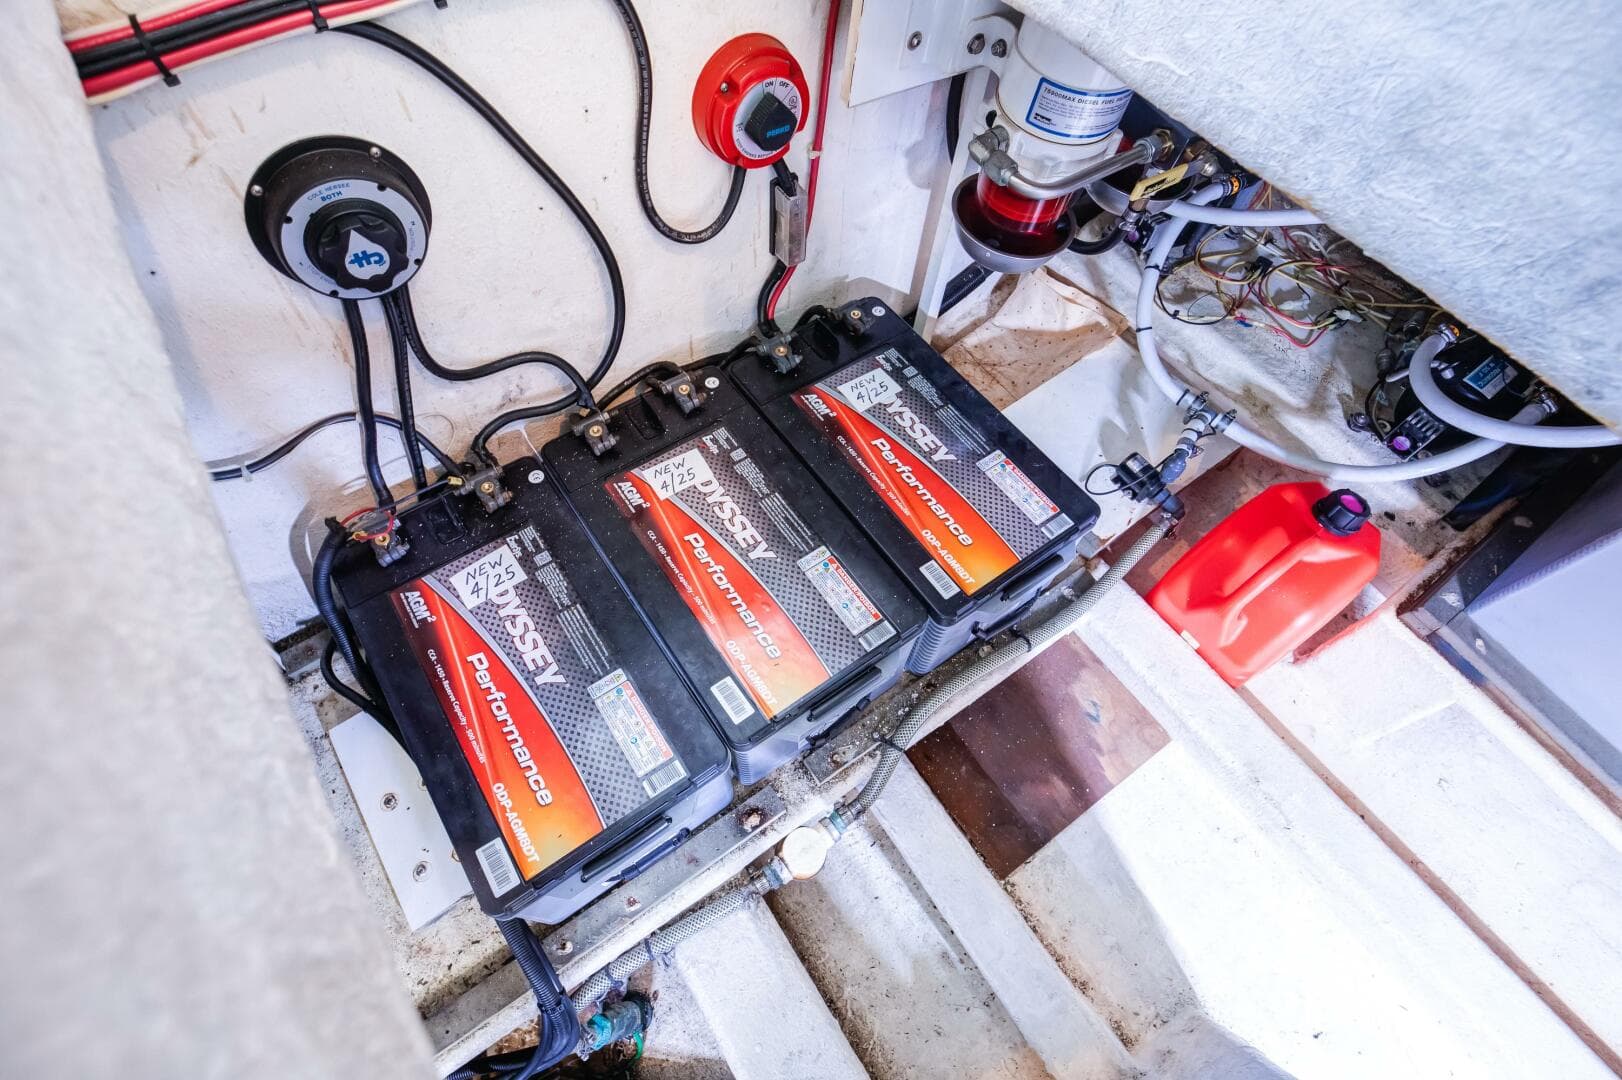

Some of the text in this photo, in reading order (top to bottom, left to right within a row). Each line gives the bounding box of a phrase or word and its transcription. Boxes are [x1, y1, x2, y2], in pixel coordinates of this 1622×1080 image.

[307, 182, 351, 201] COLE HERSEE
[320, 191, 343, 202] BOTH
[851, 374, 876, 392] NEW
[856, 382, 889, 404] 4/25
[654, 457, 685, 478] NEW
[660, 467, 696, 493] 4/25
[836, 434, 846, 445] CCA
[868, 471, 886, 490] Capacity
[694, 478, 777, 560] DYSSEY
[871, 437, 973, 546] Performance
[465, 553, 503, 585] NEW
[470, 564, 516, 600] 4/25
[646, 529, 656, 540] CCA
[664, 555, 679, 574] Reserve
[676, 572, 693, 594] Capacity
[684, 532, 782, 659] Performance
[490, 586, 568, 686] DYSSEY
[426, 648, 437, 661] CCA
[441, 679, 457, 702] Reserve
[450, 700, 468, 726] Capacity
[465, 728, 475, 741] 500
[466, 652, 553, 806] Performance
[493, 782, 540, 863] ODP-AGM8DT
